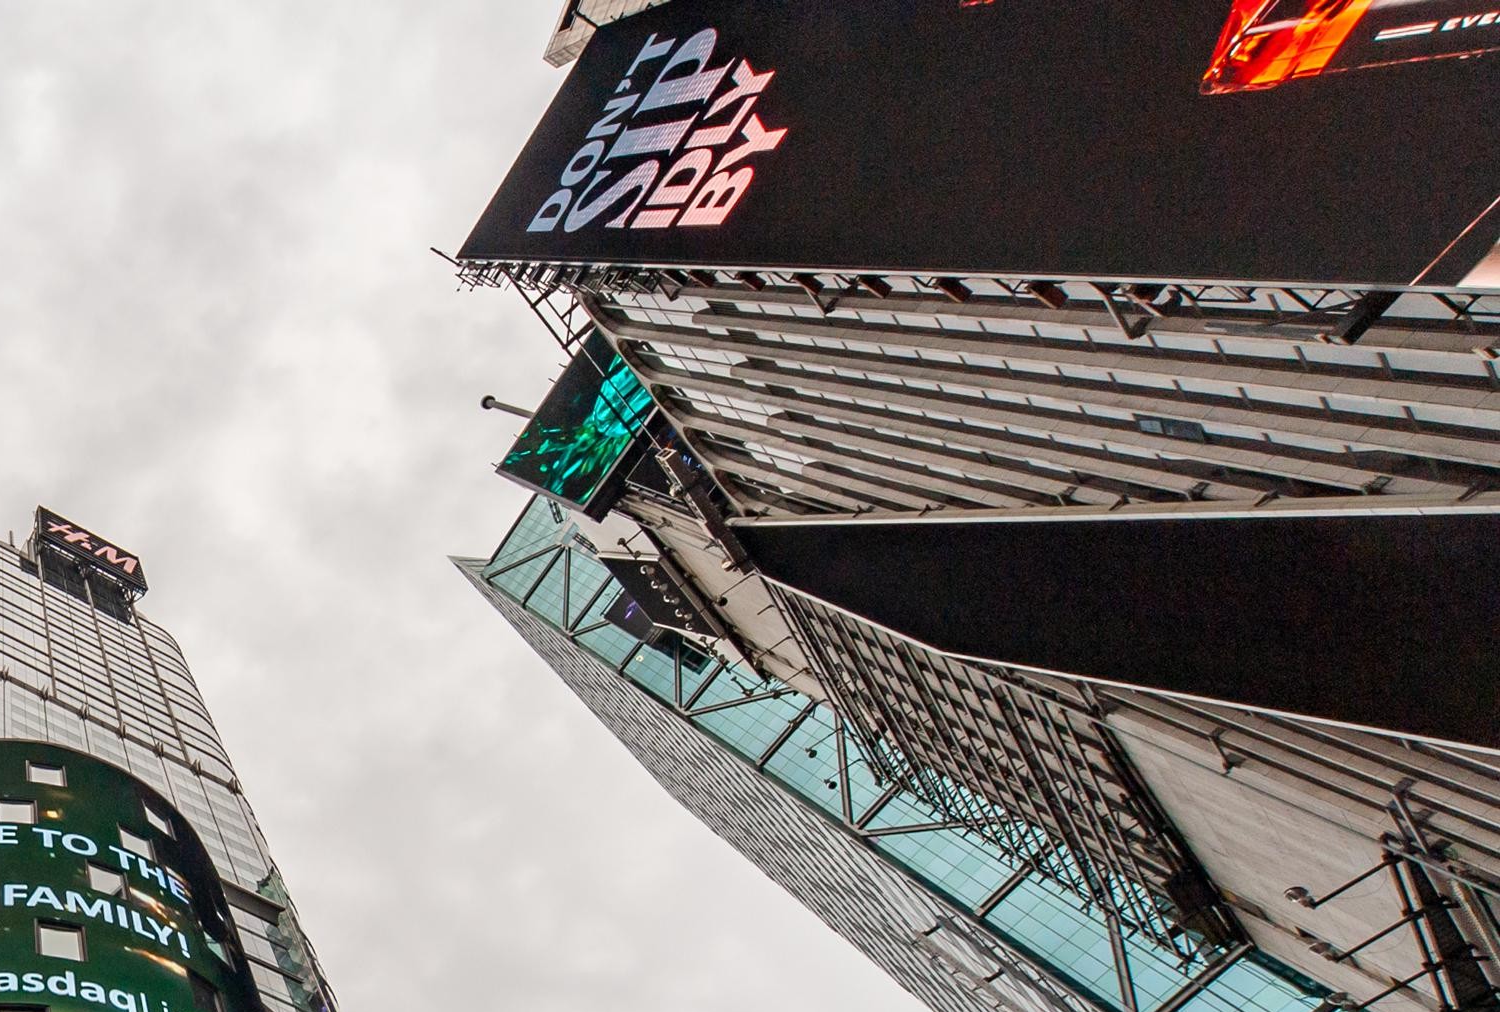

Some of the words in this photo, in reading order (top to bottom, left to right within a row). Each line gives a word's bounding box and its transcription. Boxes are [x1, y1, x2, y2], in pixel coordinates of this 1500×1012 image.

[1440, 11, 1500, 31] EVE
[526, 33, 676, 232] DON'T
[564, 27, 718, 233] SIP
[630, 57, 775, 229] IDLY
[676, 112, 788, 226] BY
[4, 884, 191, 959] FAMILY!
[32, 827, 98, 856] TO
[109, 845, 190, 904] THE
